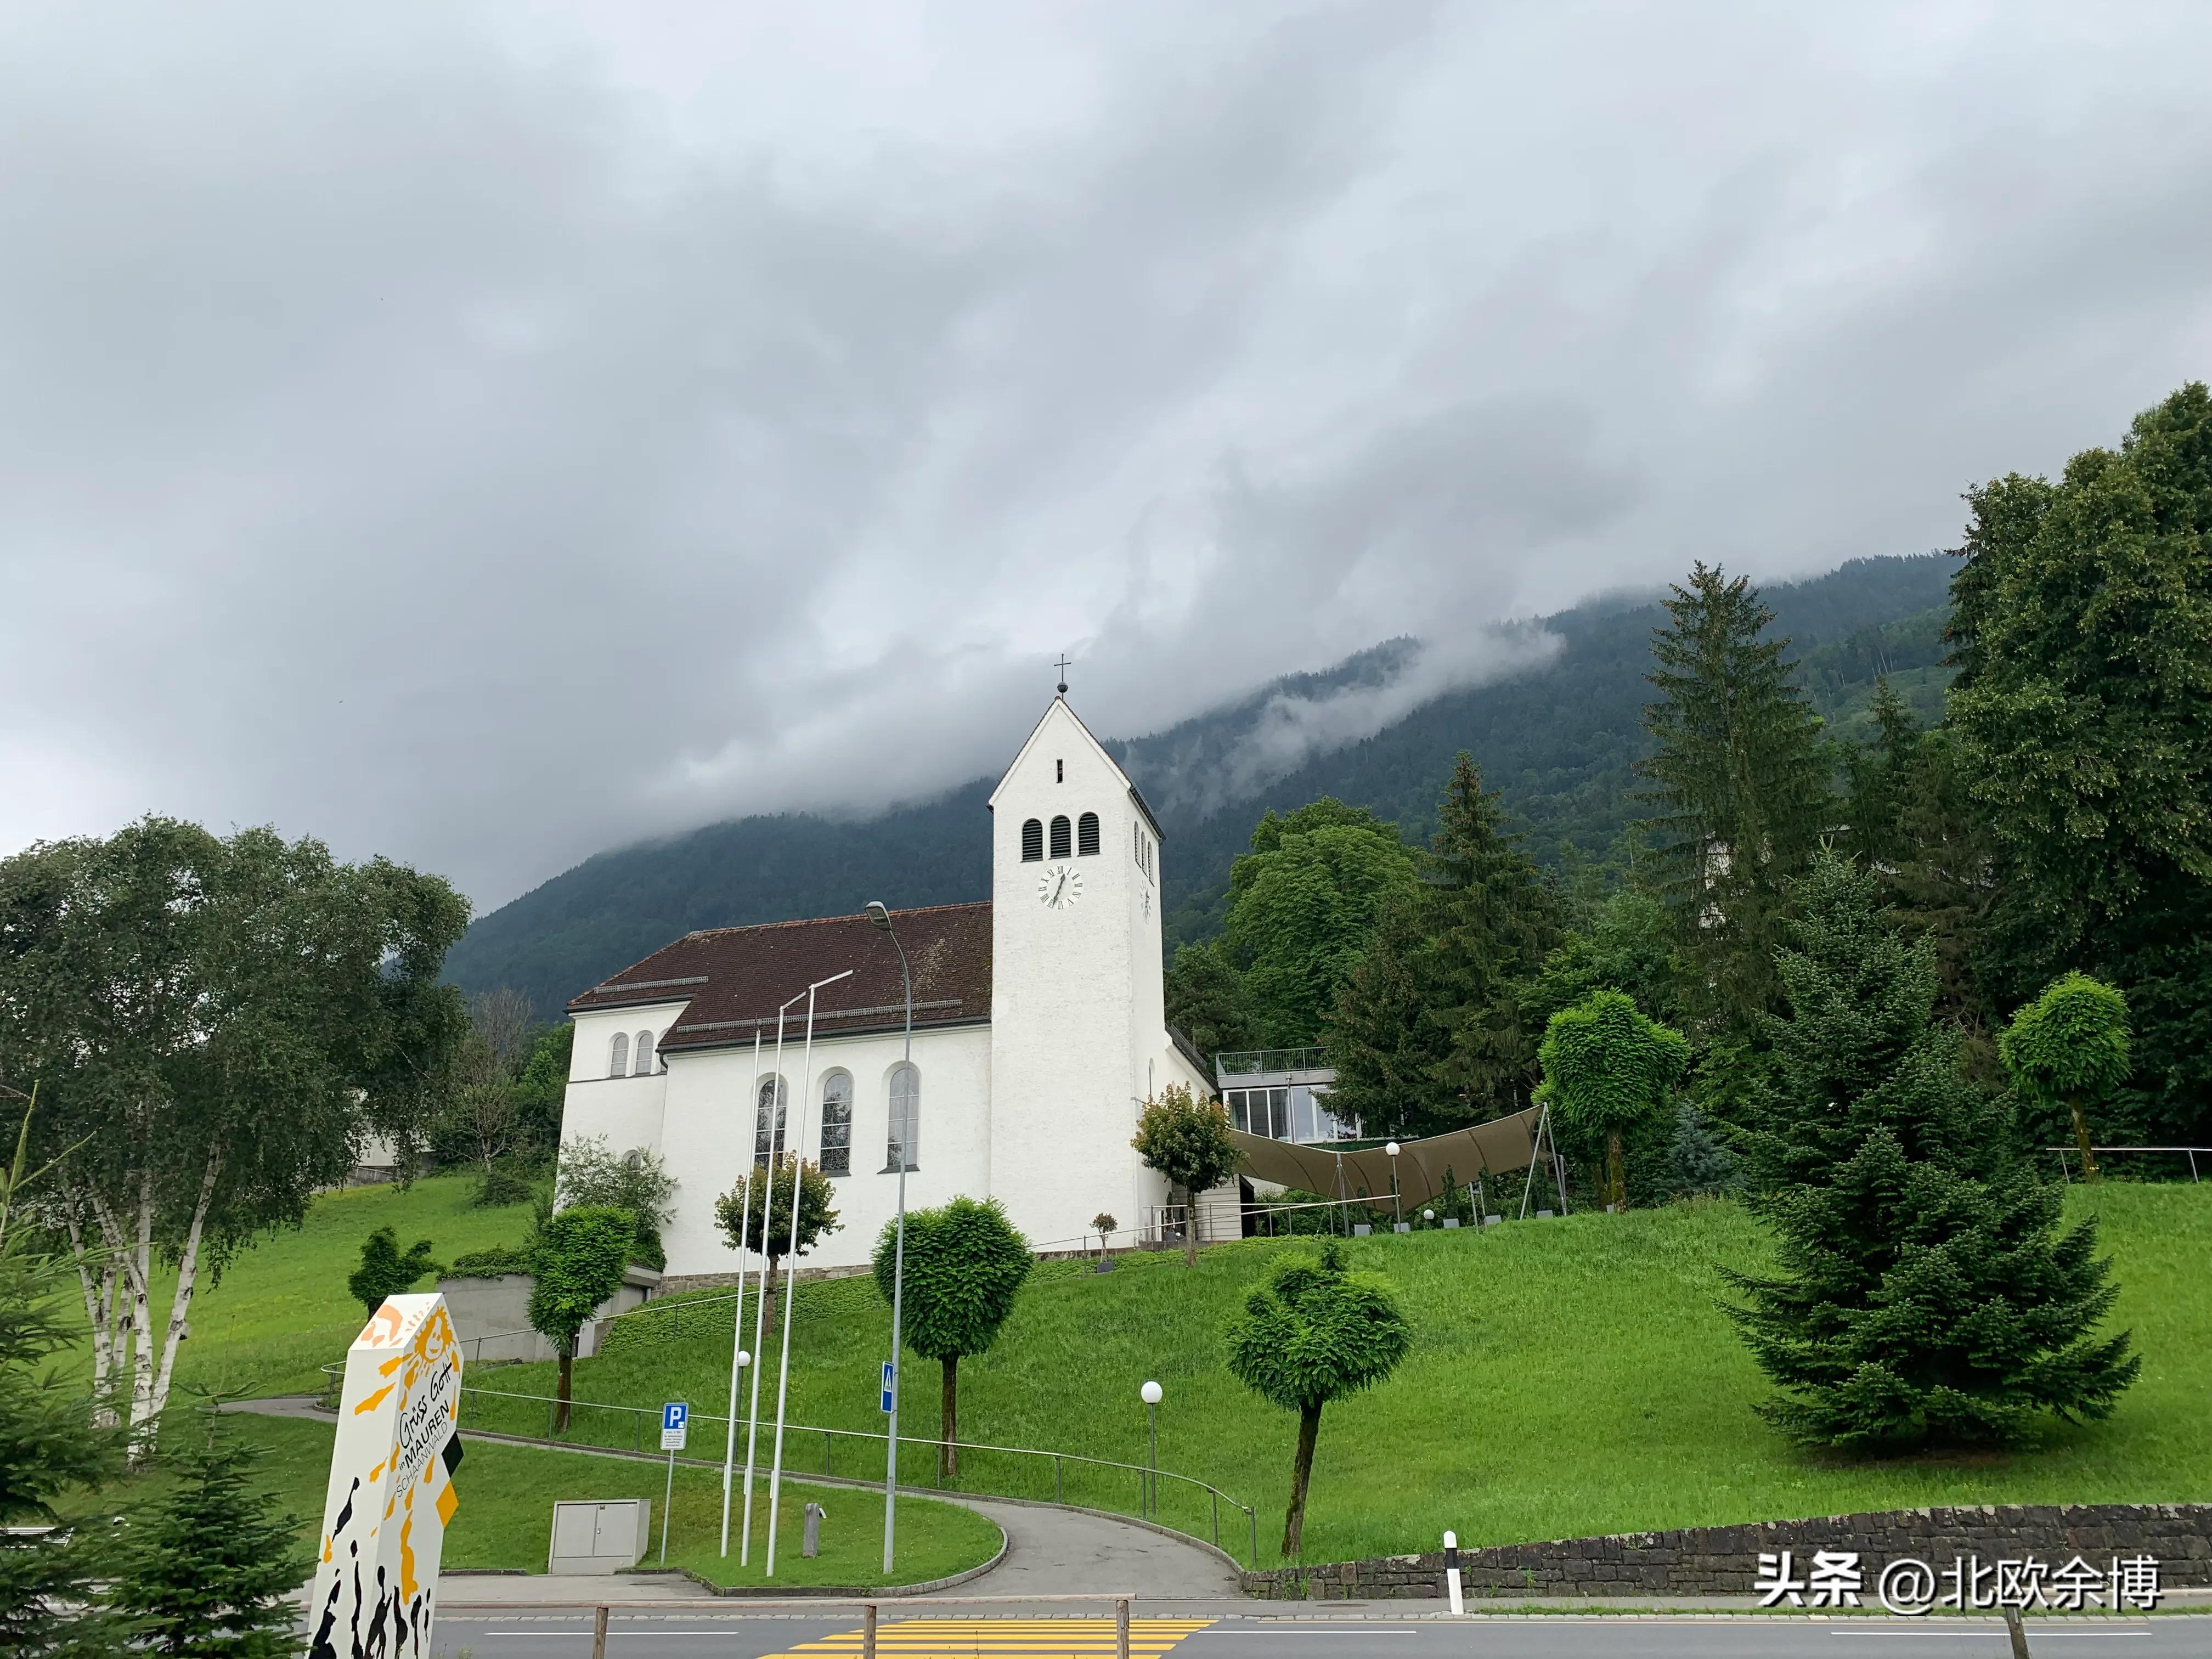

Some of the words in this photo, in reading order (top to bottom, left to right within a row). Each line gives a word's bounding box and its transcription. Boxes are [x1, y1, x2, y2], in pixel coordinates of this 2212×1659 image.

[398, 1462, 405, 1471] in
[405, 1400, 449, 1469] MAUREN
[399, 1395, 427, 1449] Grüss
[430, 1362, 453, 1402] Gott
[669, 1407, 682, 1427] P
[396, 1421, 448, 1498] SCHAANWALD
